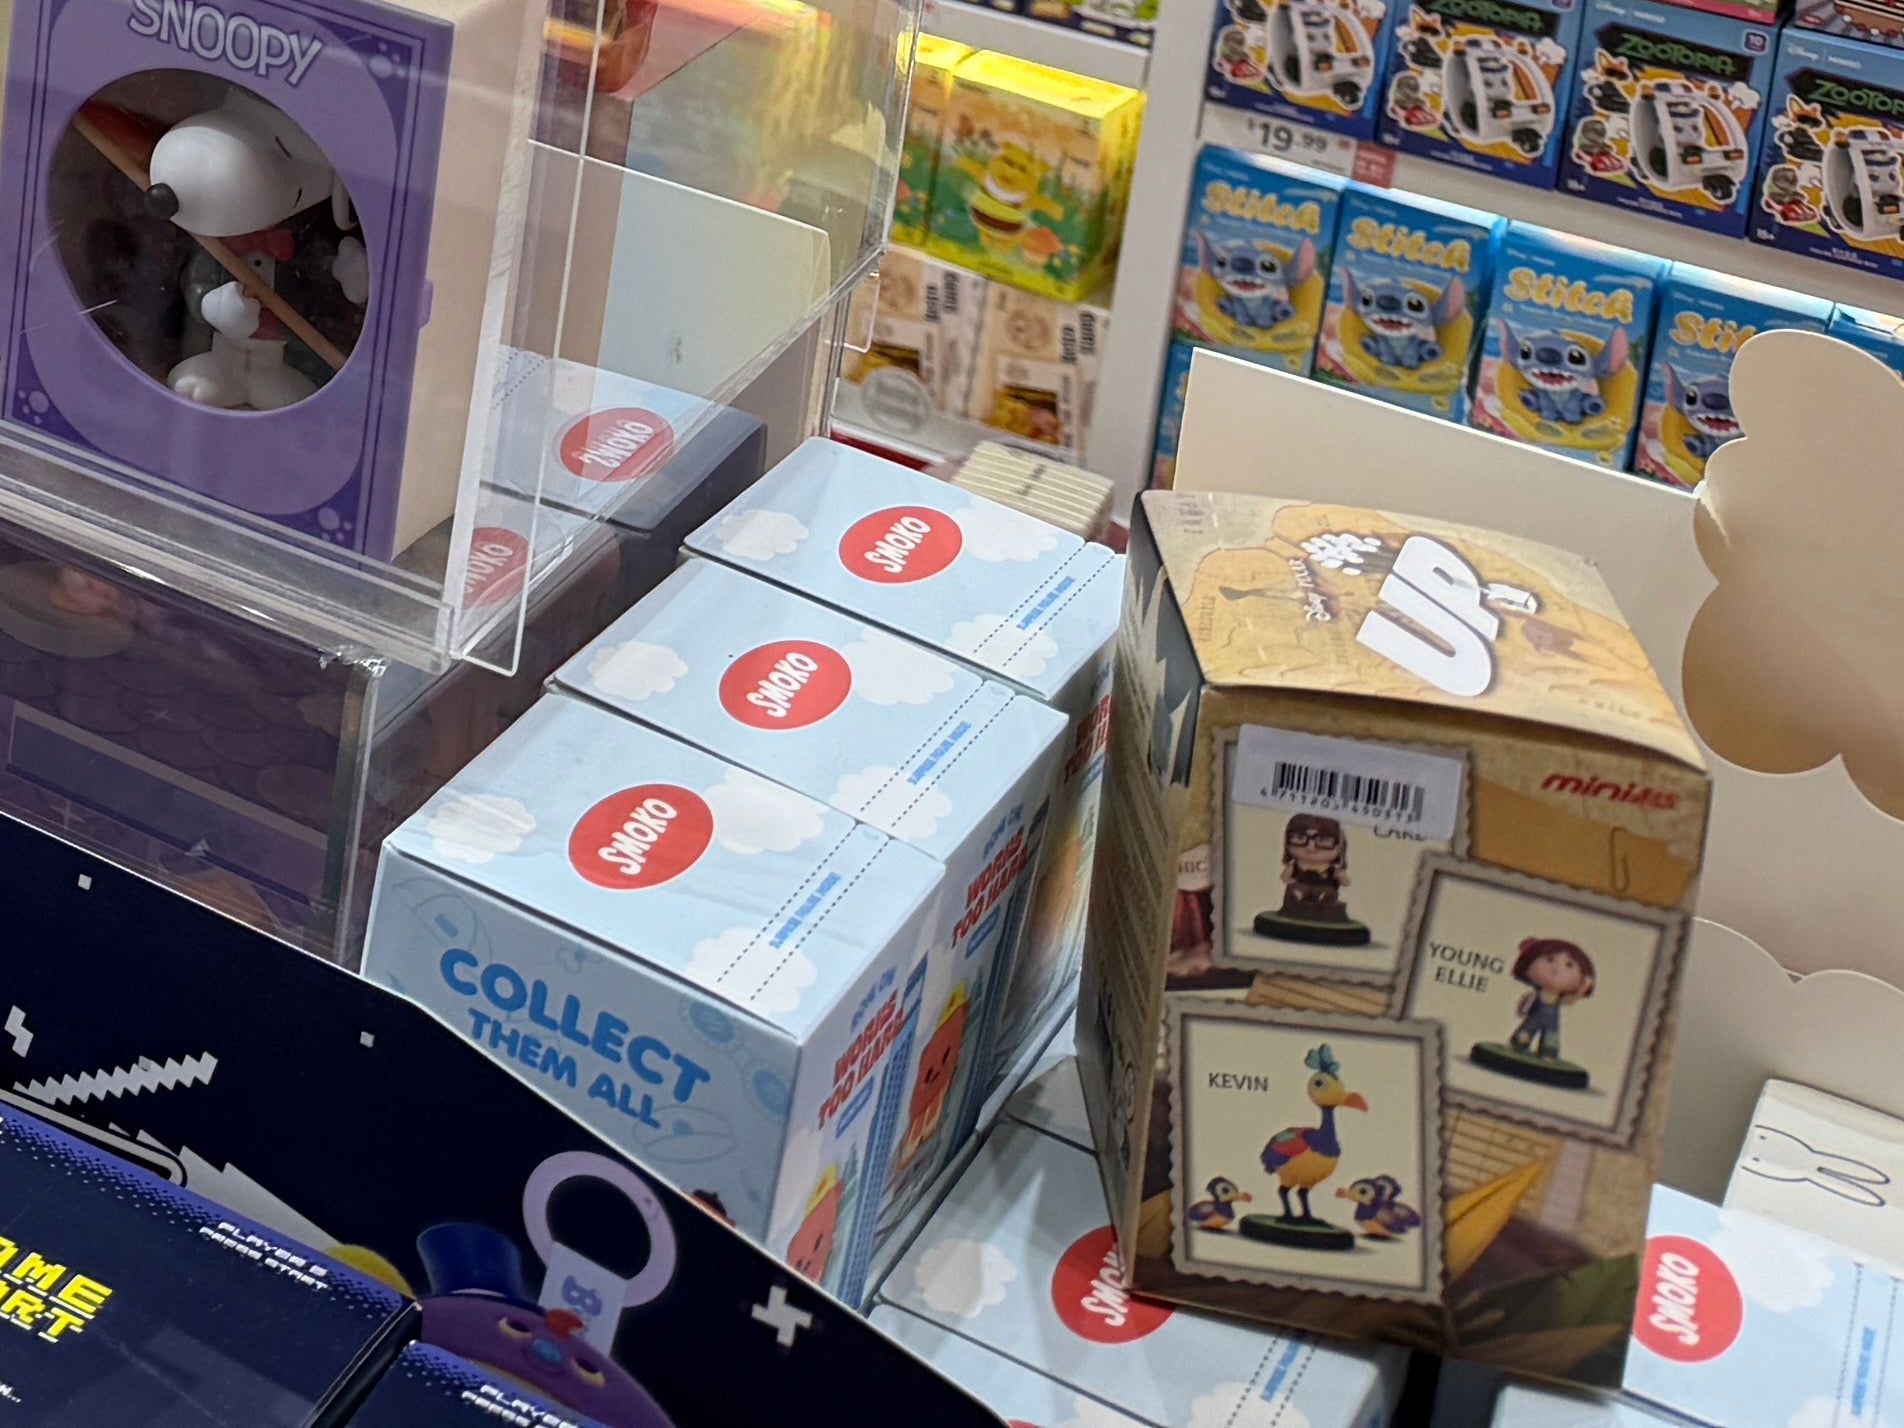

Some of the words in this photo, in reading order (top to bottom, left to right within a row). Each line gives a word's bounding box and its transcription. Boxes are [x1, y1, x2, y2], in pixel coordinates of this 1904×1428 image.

[1355, 535, 1500, 697] UP
[745, 650, 819, 718] SMOKO
[597, 797, 678, 879] SMOKO
[1430, 941, 1505, 974] YOUNG
[1435, 965, 1488, 993] ELLIE
[438, 947, 710, 1105] COLLECT
[469, 1007, 578, 1090] THEM
[586, 1069, 660, 1129] ALL
[1208, 1069, 1270, 1093] KEVIN
[1648, 1251, 1700, 1344] SMOKO
